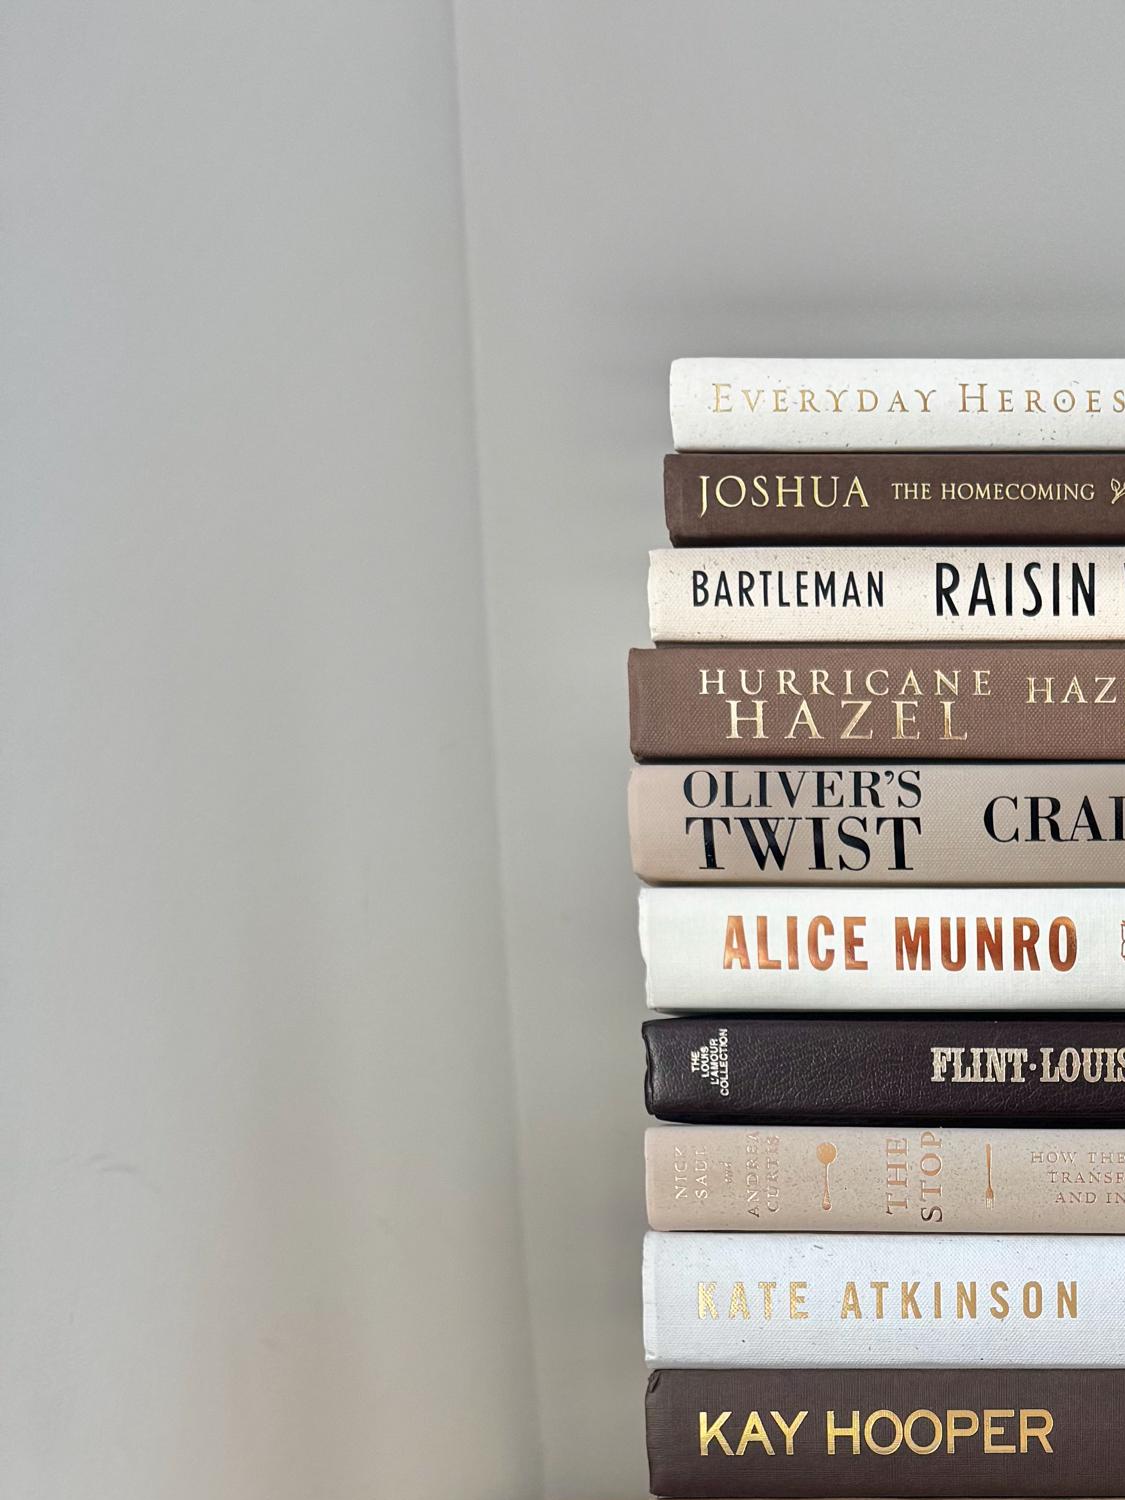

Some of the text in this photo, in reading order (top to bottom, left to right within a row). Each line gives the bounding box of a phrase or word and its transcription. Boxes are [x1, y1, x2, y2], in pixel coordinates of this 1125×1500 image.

[712, 382, 1125, 413] EVERYDAY HEROES
[699, 475, 1095, 518] JOSHUA THE HOMECOMING
[692, 570, 885, 608] BARTLEMAN
[936, 562, 1096, 617] RAISIN
[700, 669, 992, 696] HURRICANE
[726, 700, 968, 740] HAZEL
[683, 769, 922, 809] OLIVER'S
[685, 816, 921, 872] TWIST
[723, 915, 1077, 971] ALICE MUNRO
[691, 1050, 700, 1072] THE
[701, 1046, 709, 1077] LOUIS
[709, 1038, 719, 1085] L'AMOUR
[719, 1028, 729, 1096] COLLECTION
[675, 1147, 687, 1199] NICK
[695, 1147, 708, 1199] SAUL
[747, 1131, 760, 1218] ANDREA
[884, 1137, 909, 1215] THE
[921, 1131, 943, 1223] STOP
[1031, 1151, 1077, 1164] HOW
[1055, 1191, 1097, 1204] AND
[697, 1281, 1078, 1320] KATE ATKINSON
[699, 1408, 1054, 1456] KAY HOOPER
